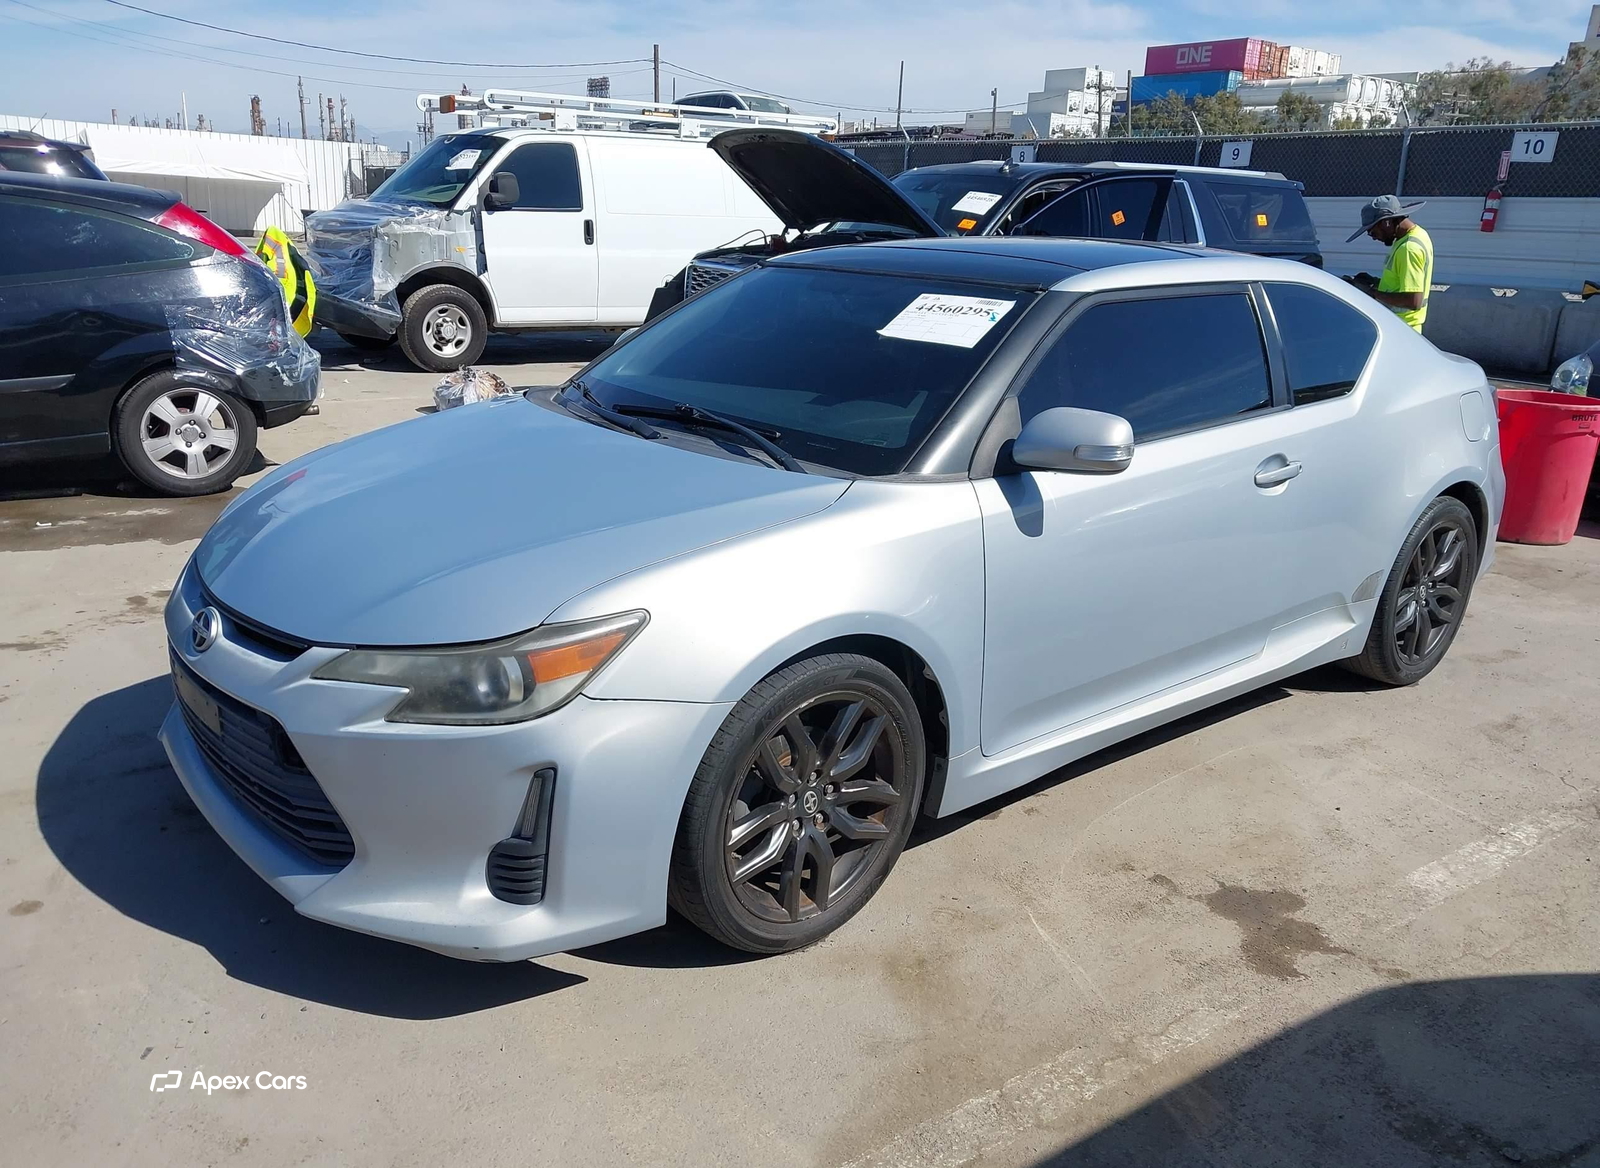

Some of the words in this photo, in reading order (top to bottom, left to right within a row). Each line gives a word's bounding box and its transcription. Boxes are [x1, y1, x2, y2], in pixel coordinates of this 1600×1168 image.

[1176, 45, 1213, 64] ONE
[1232, 148, 1240, 160] 9
[1523, 139, 1545, 155] 10
[1020, 151, 1026, 162] 8
[915, 302, 995, 317] 44560295
